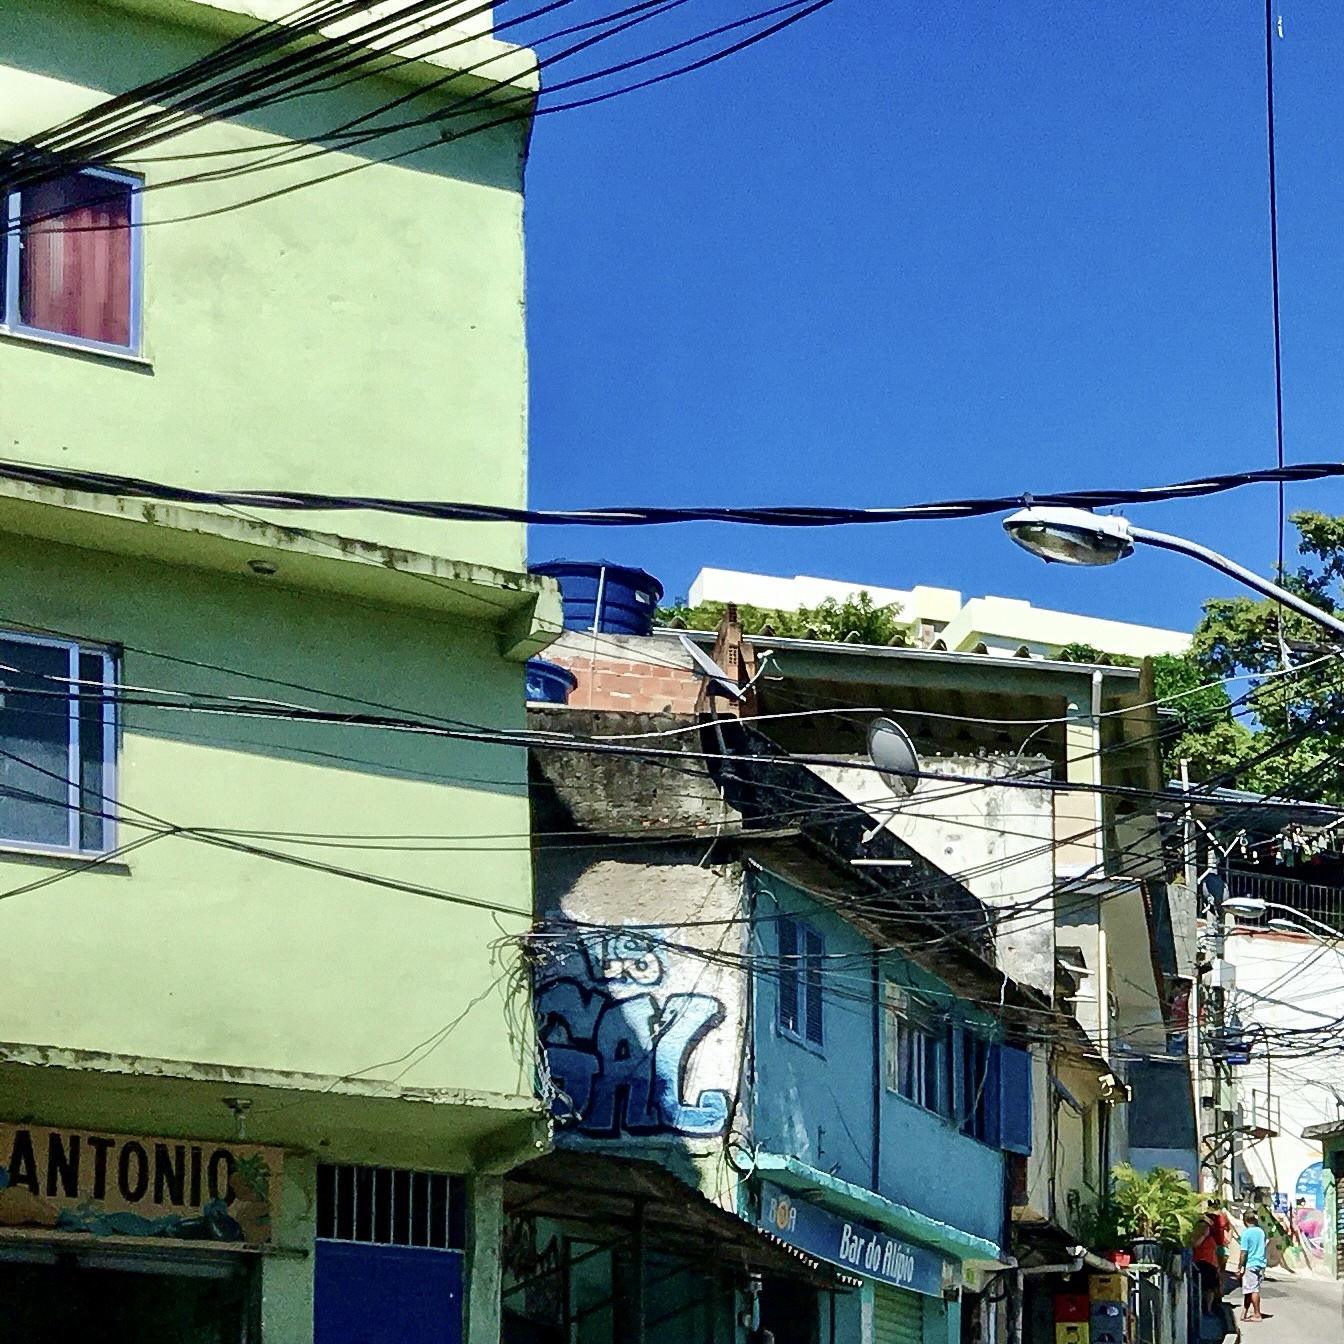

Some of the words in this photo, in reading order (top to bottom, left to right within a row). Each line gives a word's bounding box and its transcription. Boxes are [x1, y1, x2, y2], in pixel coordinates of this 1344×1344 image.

[7, 1130, 235, 1207] ANTONIO
[840, 1224, 866, 1266] Bar
[865, 1235, 882, 1272] do
